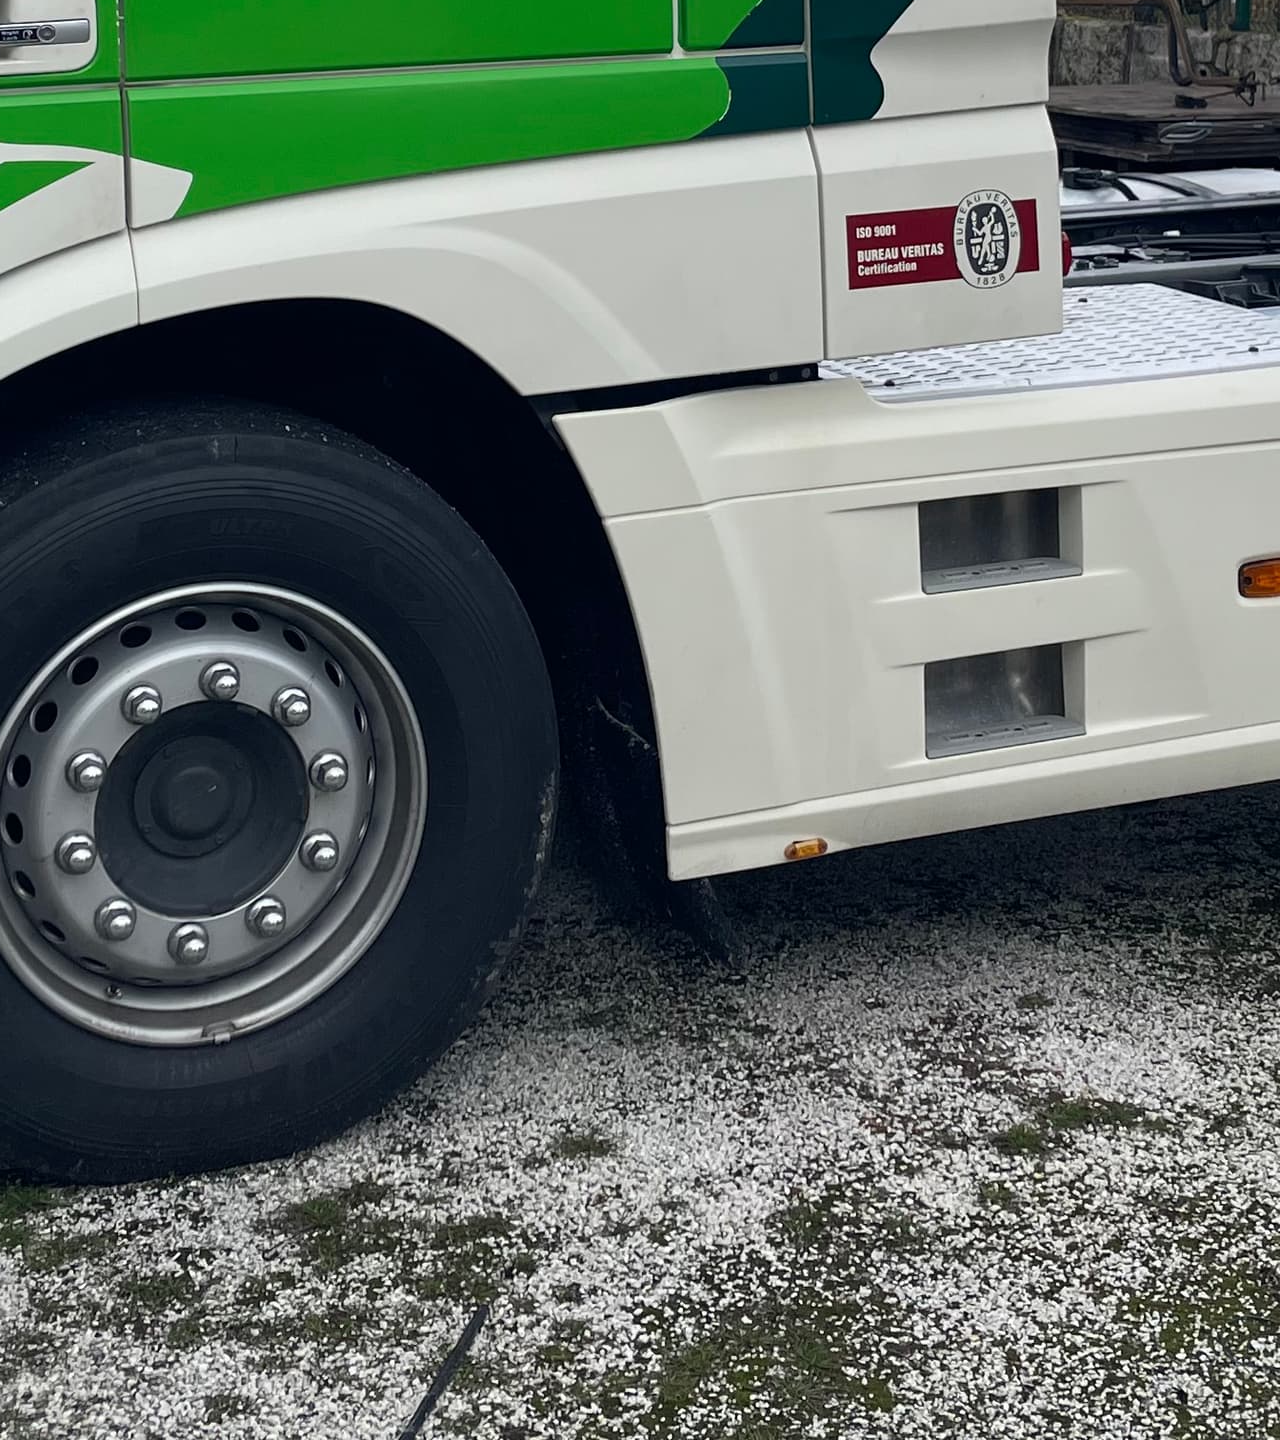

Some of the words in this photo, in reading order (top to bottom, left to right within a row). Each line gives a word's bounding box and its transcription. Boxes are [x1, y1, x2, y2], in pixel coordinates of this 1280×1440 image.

[956, 195, 981, 246] BUREAU
[986, 192, 1019, 238] VERITAS
[856, 226, 872, 239] ISO
[873, 224, 897, 237] 9001
[857, 246, 899, 263] BUREAU
[900, 242, 945, 259] VERITAS
[857, 261, 918, 277] Certification
[976, 272, 1006, 286] 1828
